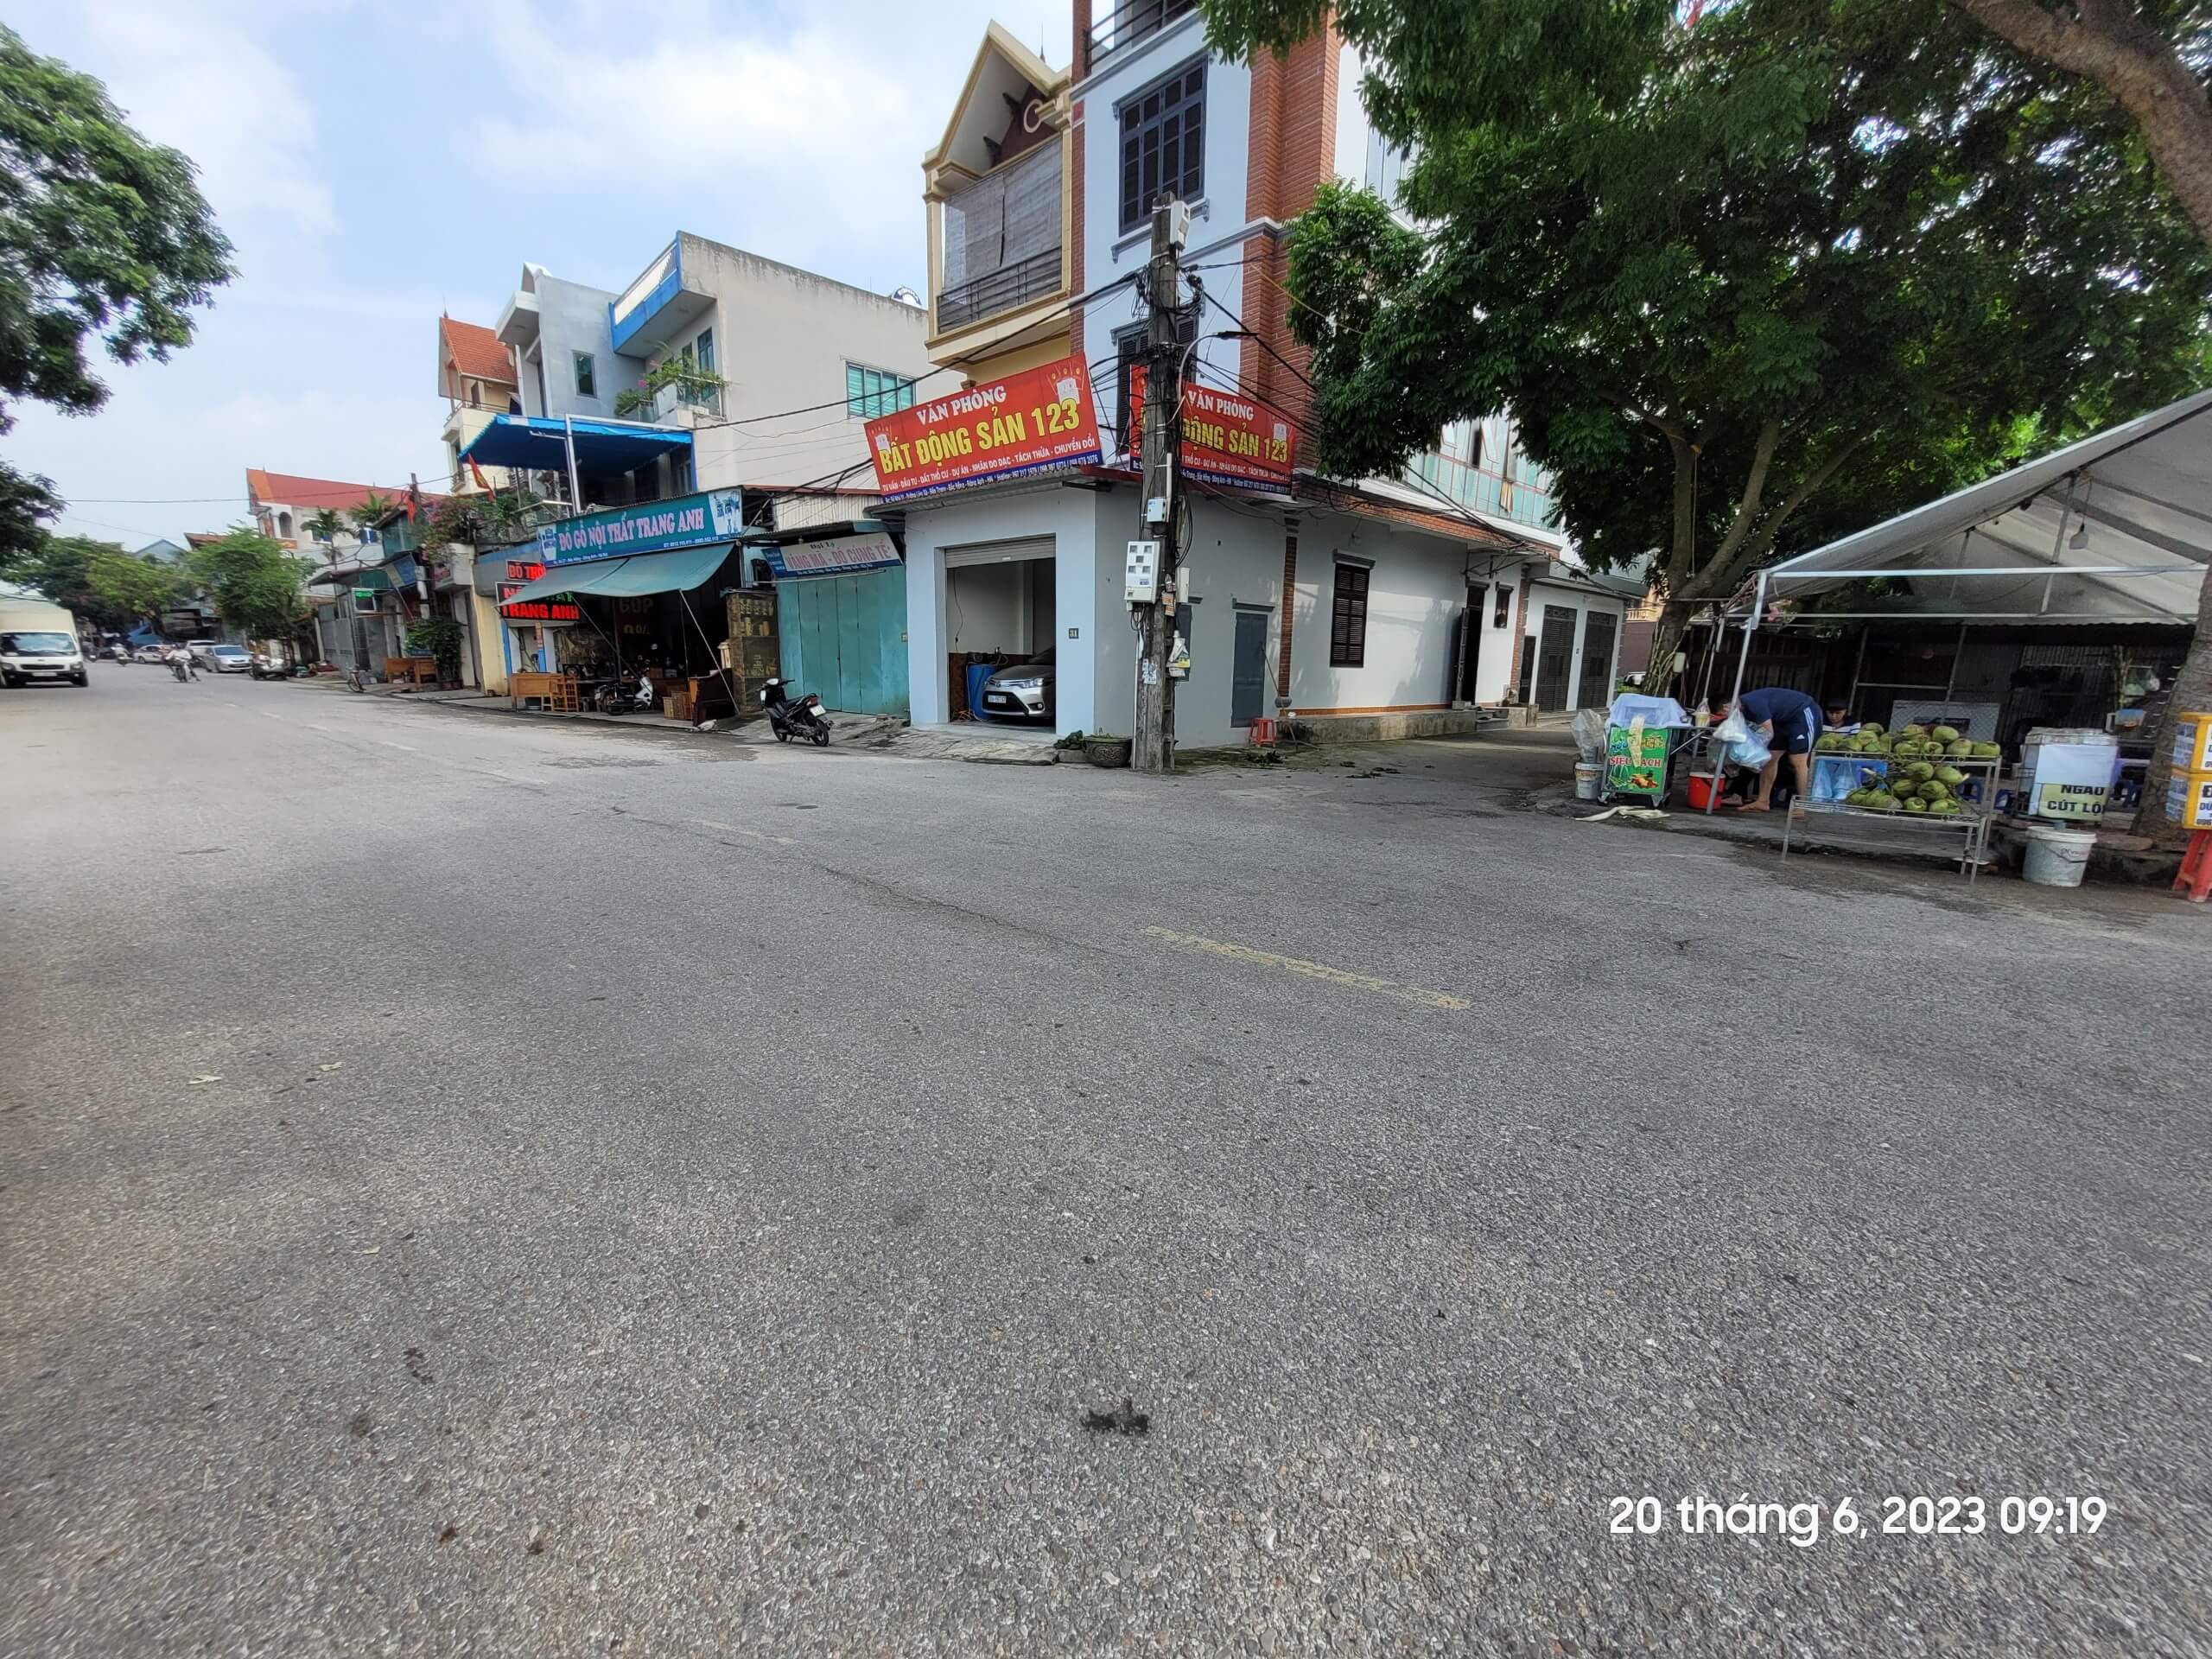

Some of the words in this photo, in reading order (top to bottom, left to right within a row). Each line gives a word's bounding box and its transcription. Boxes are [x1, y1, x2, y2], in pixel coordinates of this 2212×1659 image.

[916, 402, 949, 426] VĂN
[950, 386, 1007, 416] PHÒNG
[1187, 390, 1213, 411] VĂN
[1216, 398, 1254, 421] PHÒNG
[879, 435, 912, 474] BẤT
[915, 428, 973, 467] ĐỘNG
[976, 406, 1027, 450] SẢN
[1031, 398, 1080, 437] 123
[1228, 422, 1259, 457] SẢN
[1264, 437, 1287, 463] 123
[588, 520, 607, 550] NỘI
[607, 512, 634, 543] THẤT
[636, 512, 675, 537] TRANG
[677, 507, 704, 532] ANH
[846, 545, 875, 563] CÚNG
[551, 604, 580, 620] ANH
[2047, 799, 2078, 811] CÚT
